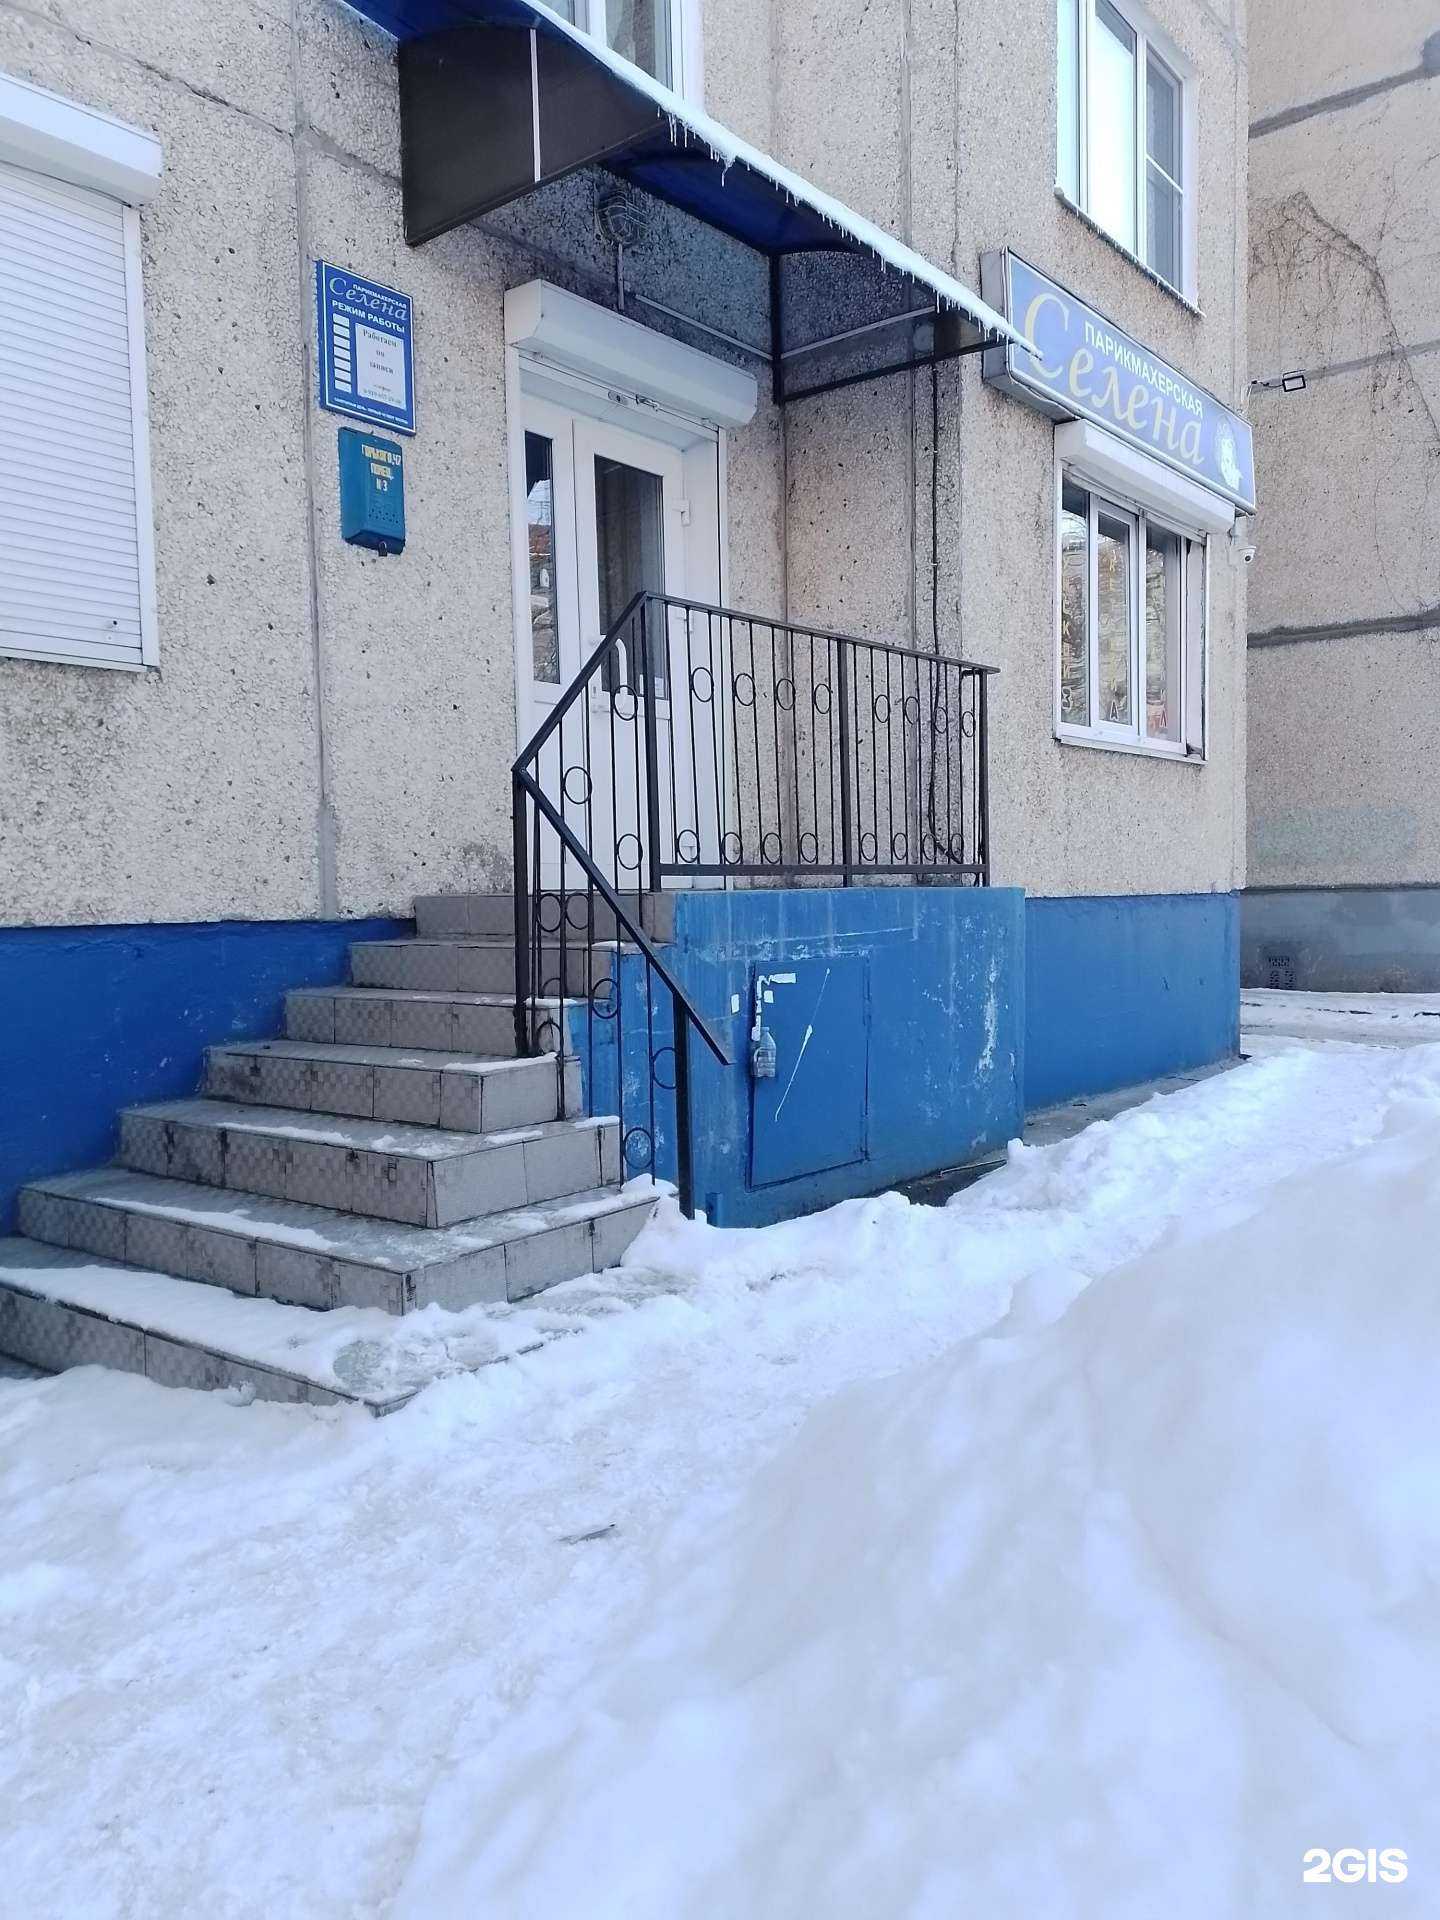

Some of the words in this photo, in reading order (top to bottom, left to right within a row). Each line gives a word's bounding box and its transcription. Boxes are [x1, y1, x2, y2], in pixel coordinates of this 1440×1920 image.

[329, 277, 408, 321] Селена
[352, 283, 407, 310] ПАРИКМАХЕРСКАЯ
[331, 299, 366, 319] РЕЖИМ
[367, 313, 405, 334] РАБОТЫ
[363, 328, 397, 348] Работаем
[1024, 292, 1205, 465] Селена
[1084, 320, 1203, 418] ПАРИКМАХЕРСКАЯ
